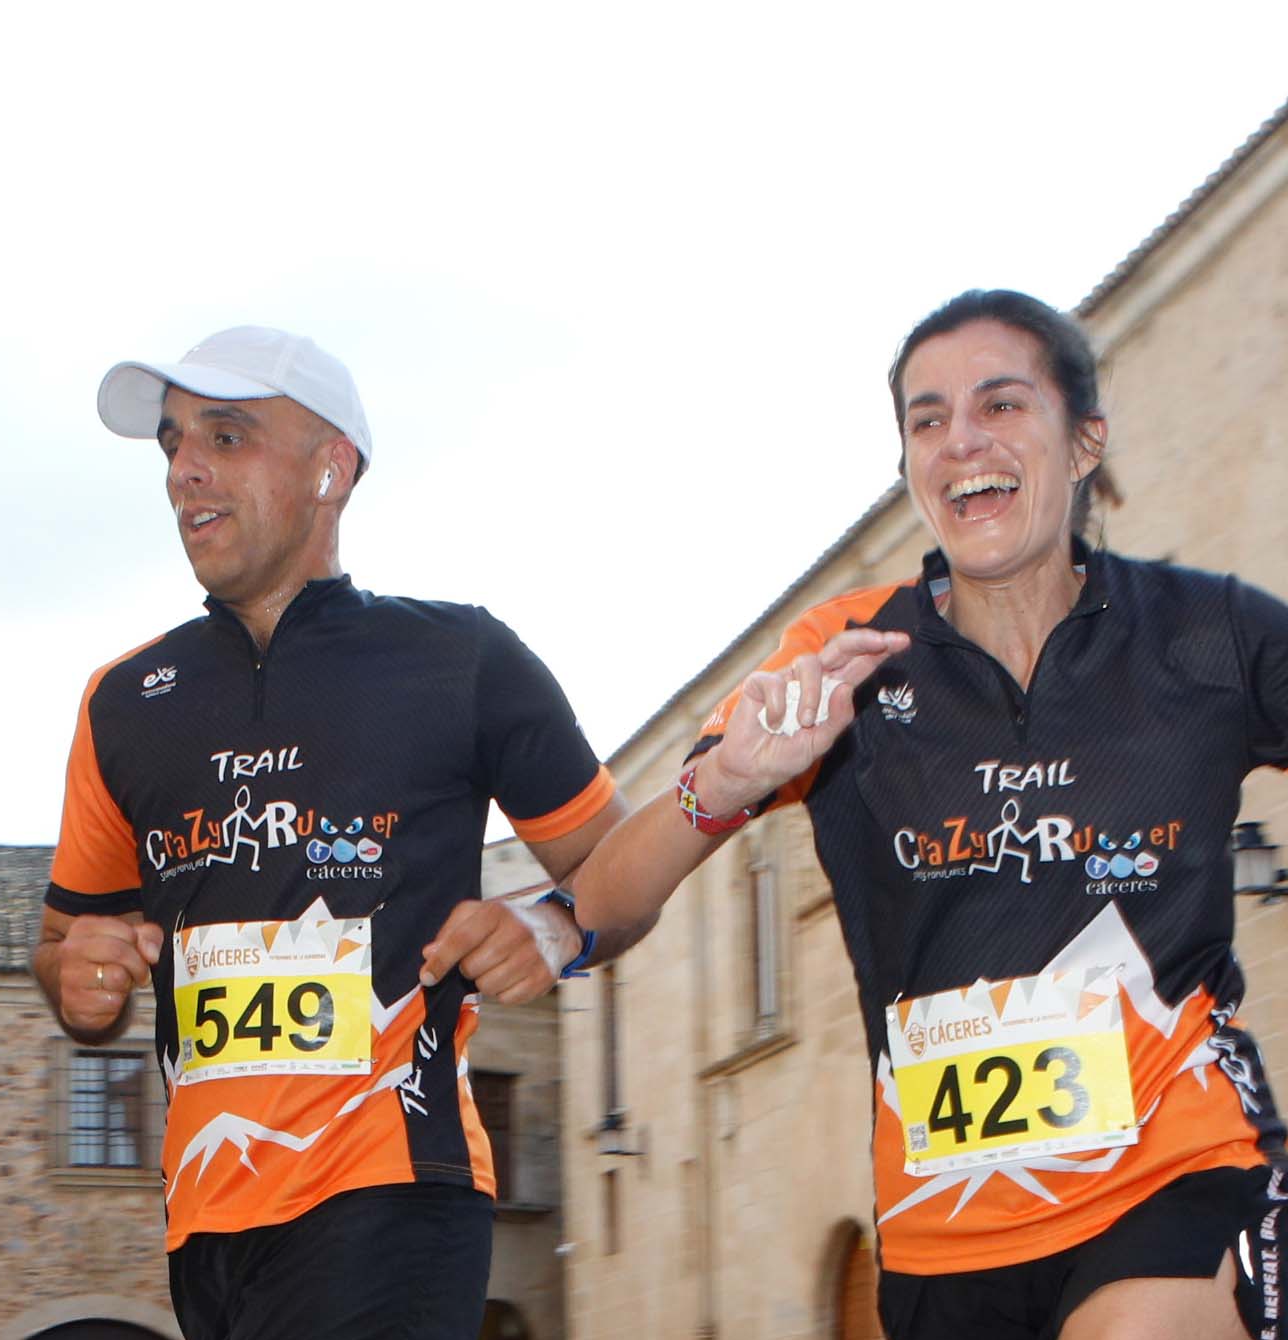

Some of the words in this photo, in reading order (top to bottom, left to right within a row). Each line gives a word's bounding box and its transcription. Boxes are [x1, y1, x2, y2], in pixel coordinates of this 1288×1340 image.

[210, 745, 304, 782] TRAIL
[974, 758, 1079, 794] TRAIL
[202, 945, 261, 969] CÁCERES
[195, 981, 335, 1059] 549
[928, 1015, 993, 1046] CÁCERES
[928, 1046, 1091, 1145] 423
